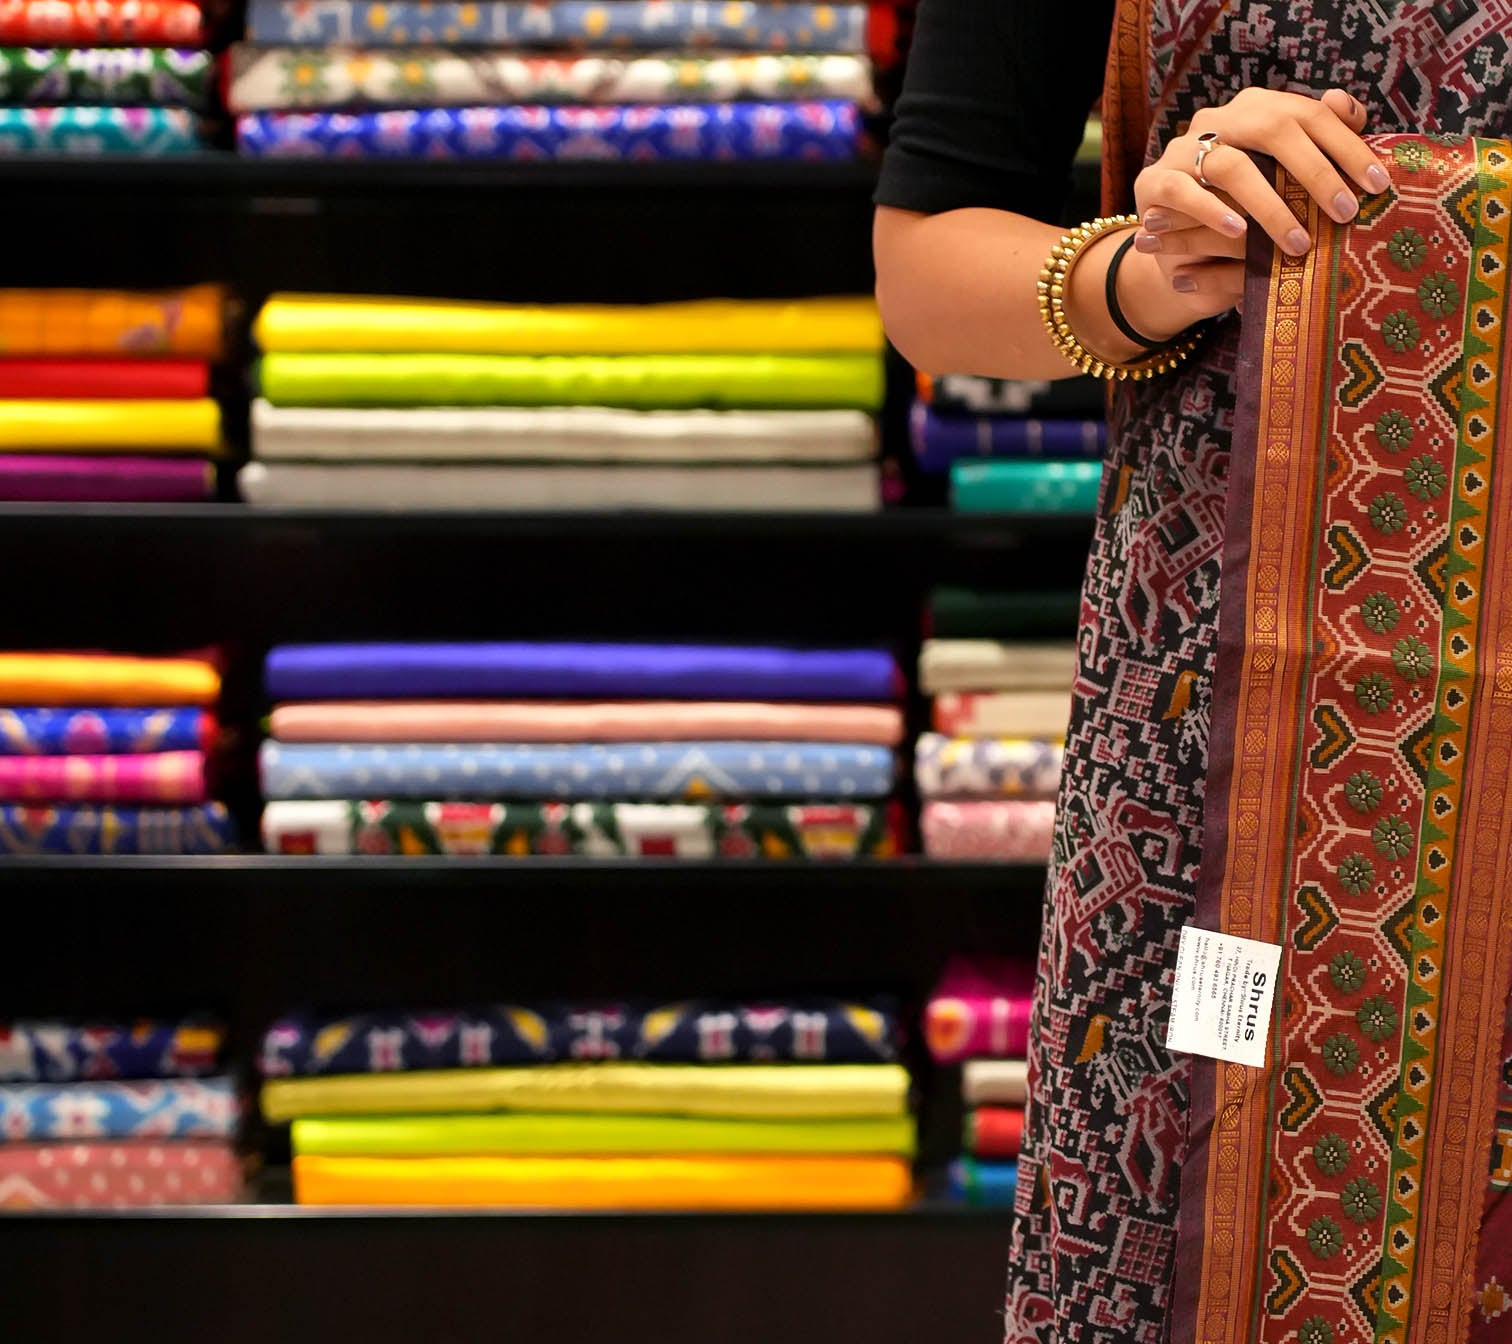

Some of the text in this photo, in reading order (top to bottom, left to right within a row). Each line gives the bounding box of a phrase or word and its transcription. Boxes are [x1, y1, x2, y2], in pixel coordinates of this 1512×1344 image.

[1244, 960, 1253, 979] Trade
[1244, 972, 1266, 1041] Shrus
[1234, 1014, 1243, 1042] Eternity
